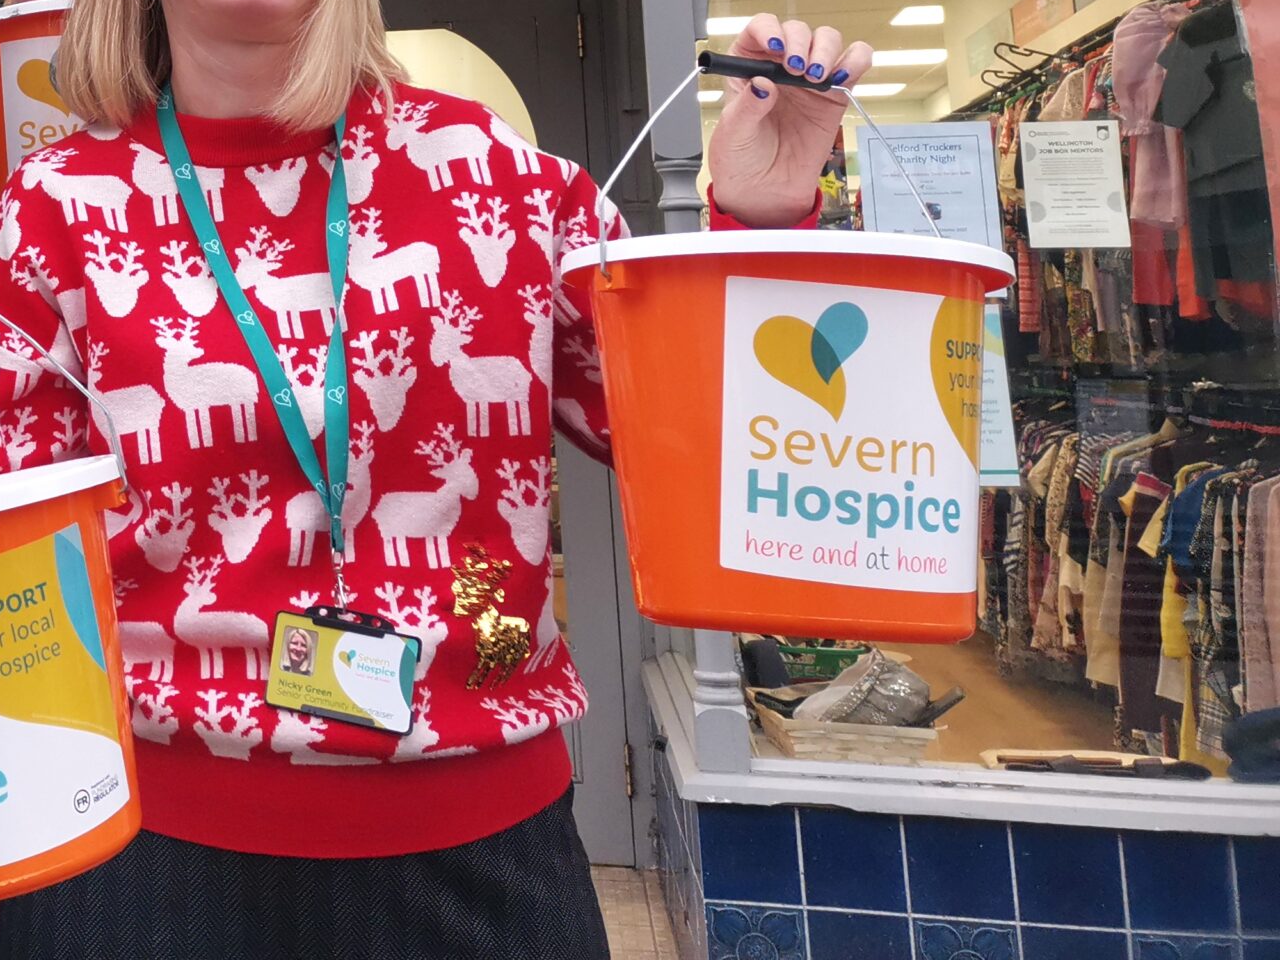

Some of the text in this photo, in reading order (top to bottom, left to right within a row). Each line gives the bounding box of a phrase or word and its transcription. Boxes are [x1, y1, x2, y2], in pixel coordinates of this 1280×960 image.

[922, 142, 962, 152] Truckers
[930, 154, 956, 165] Night
[748, 414, 936, 478] Severn
[746, 468, 961, 539] Hospice
[745, 529, 948, 574] here and at home
[10, 607, 56, 642] local
[356, 662, 396, 678] Hospice
[278, 678, 332, 698] Nicky Green
[76, 795, 88, 808] FR
